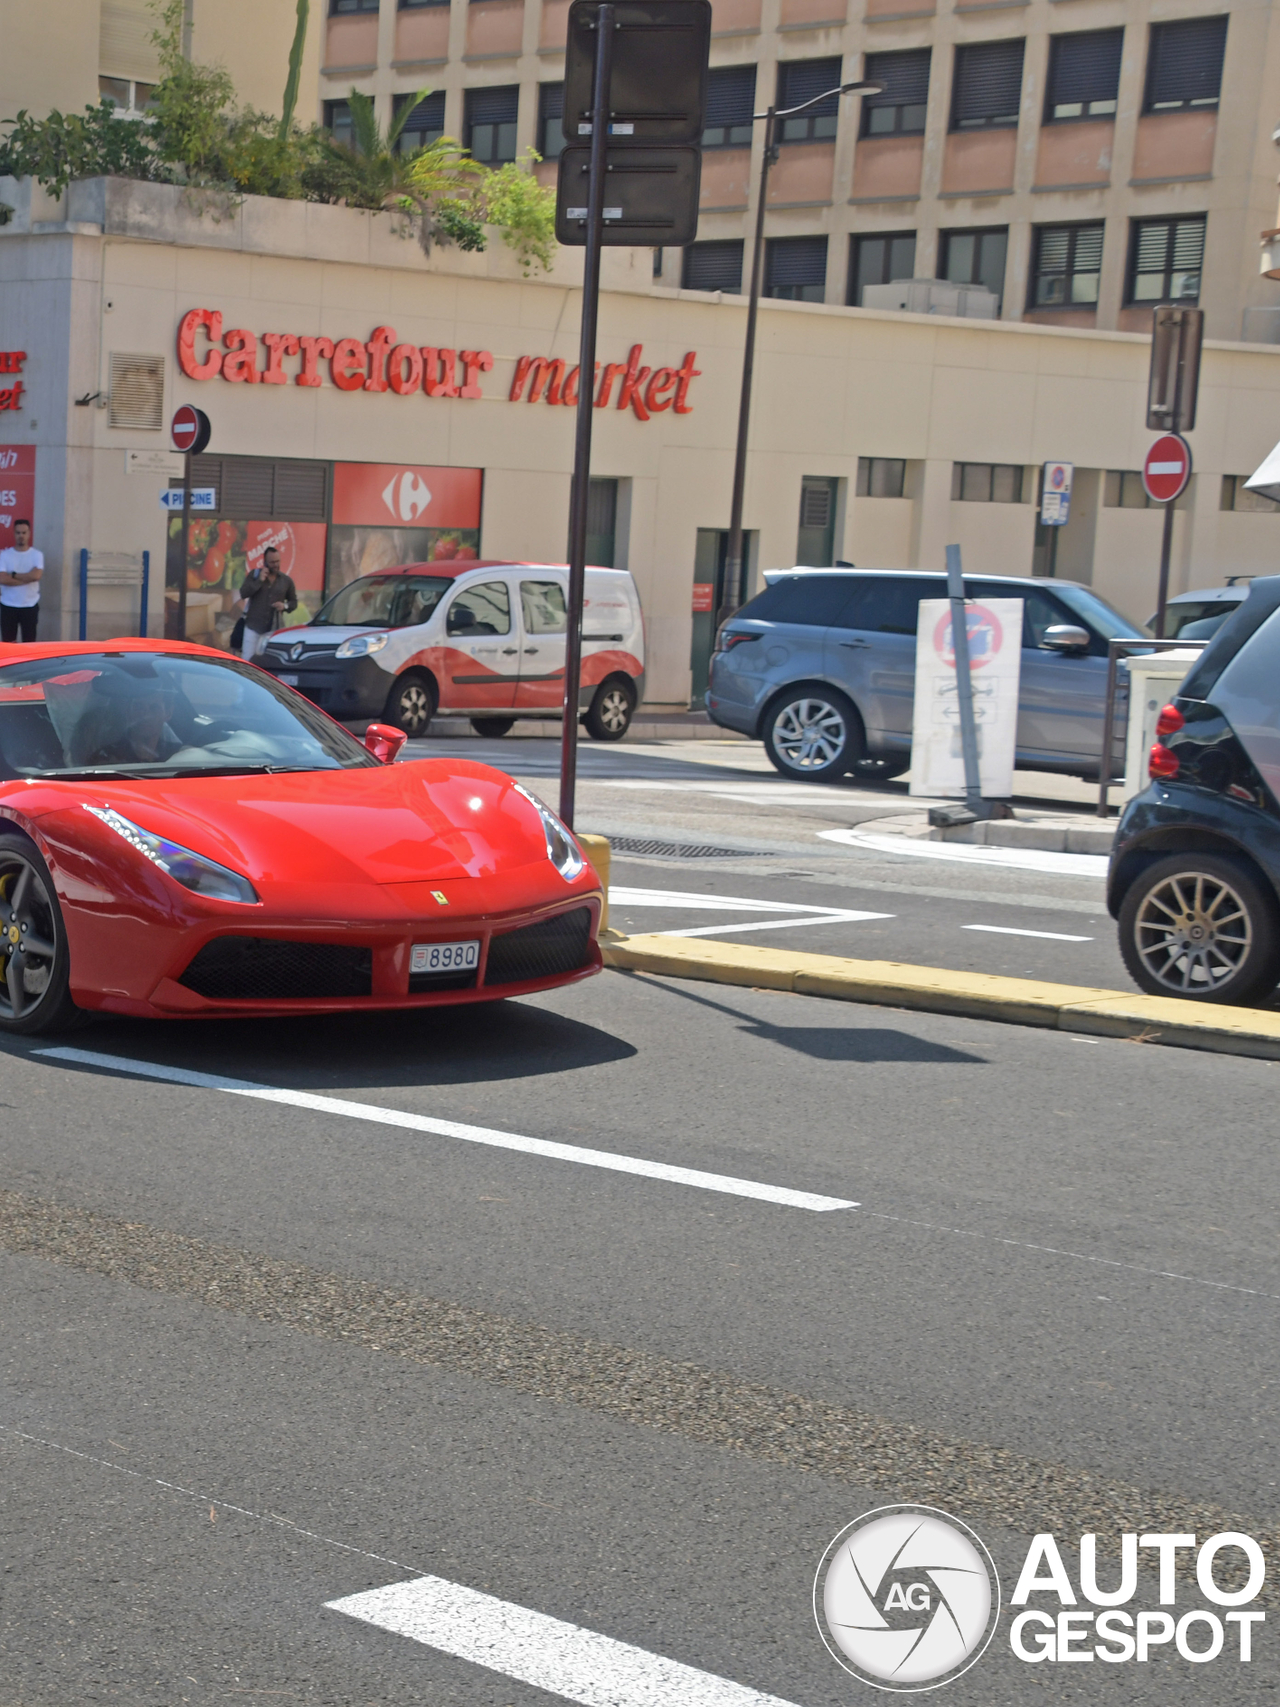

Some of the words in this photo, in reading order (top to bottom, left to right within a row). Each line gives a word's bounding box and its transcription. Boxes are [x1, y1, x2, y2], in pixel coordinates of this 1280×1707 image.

[177, 307, 494, 399] Carrefour
[508, 343, 703, 422] market
[172, 493, 213, 506] PICINE
